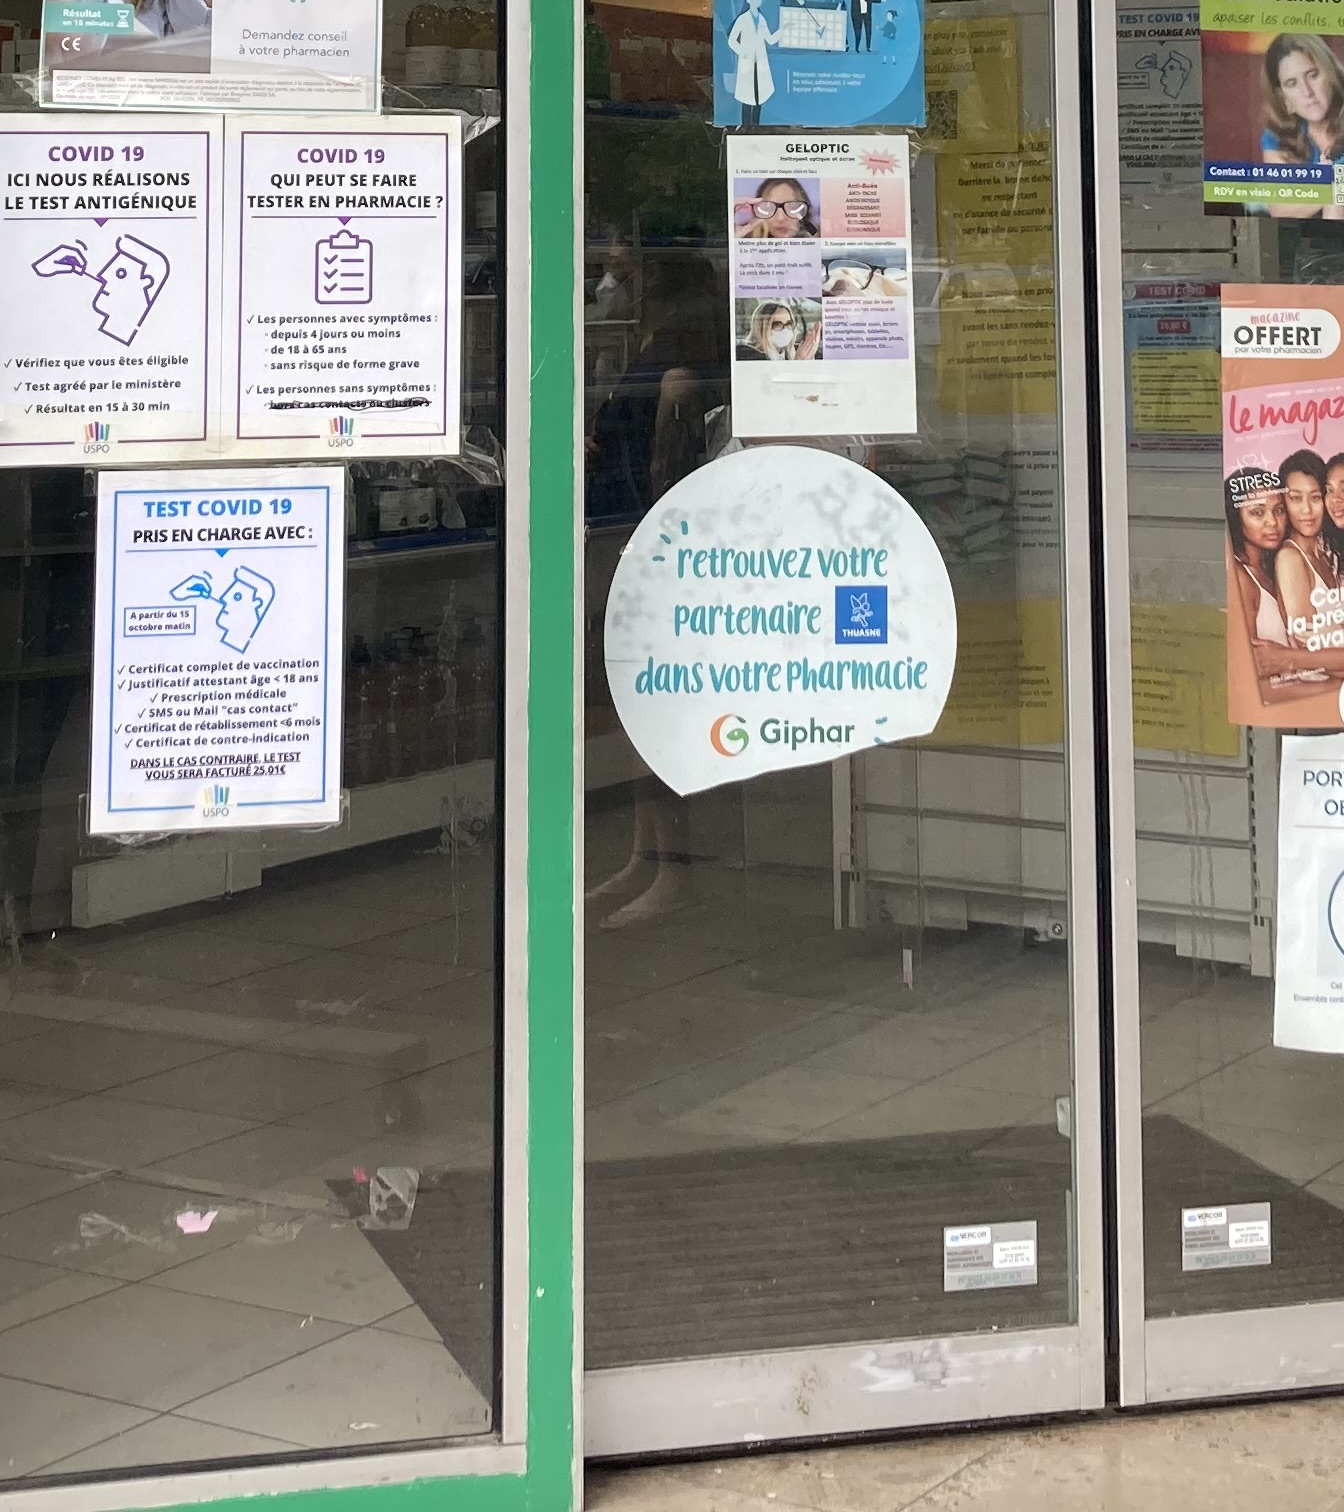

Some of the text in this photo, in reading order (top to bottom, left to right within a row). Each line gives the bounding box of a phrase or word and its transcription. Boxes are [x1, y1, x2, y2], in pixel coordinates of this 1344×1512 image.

[1119, 14, 1144, 24] TEST
[1147, 13, 1183, 23] COVID
[1134, 28, 1183, 37] EN CHARGE
[48, 145, 144, 163] COVID 19
[785, 143, 849, 153] GELOPTIC
[7, 169, 190, 188] ICI NOUS RÉALISONS
[5, 192, 197, 212] LE TEST ANTIGÉNIQUE
[1234, 324, 1322, 348] OFFERT
[25, 378, 181, 394] Test agréé par le ministère
[1229, 394, 1252, 433] le
[1229, 471, 1280, 493] STRESS
[144, 499, 292, 517] TEST COVID 19
[677, 547, 888, 579] retrouvez votre
[674, 601, 821, 636] partenaire
[1287, 615, 1310, 637] la
[161, 689, 287, 703] Prescription médicale
[760, 717, 855, 750] Giphar
